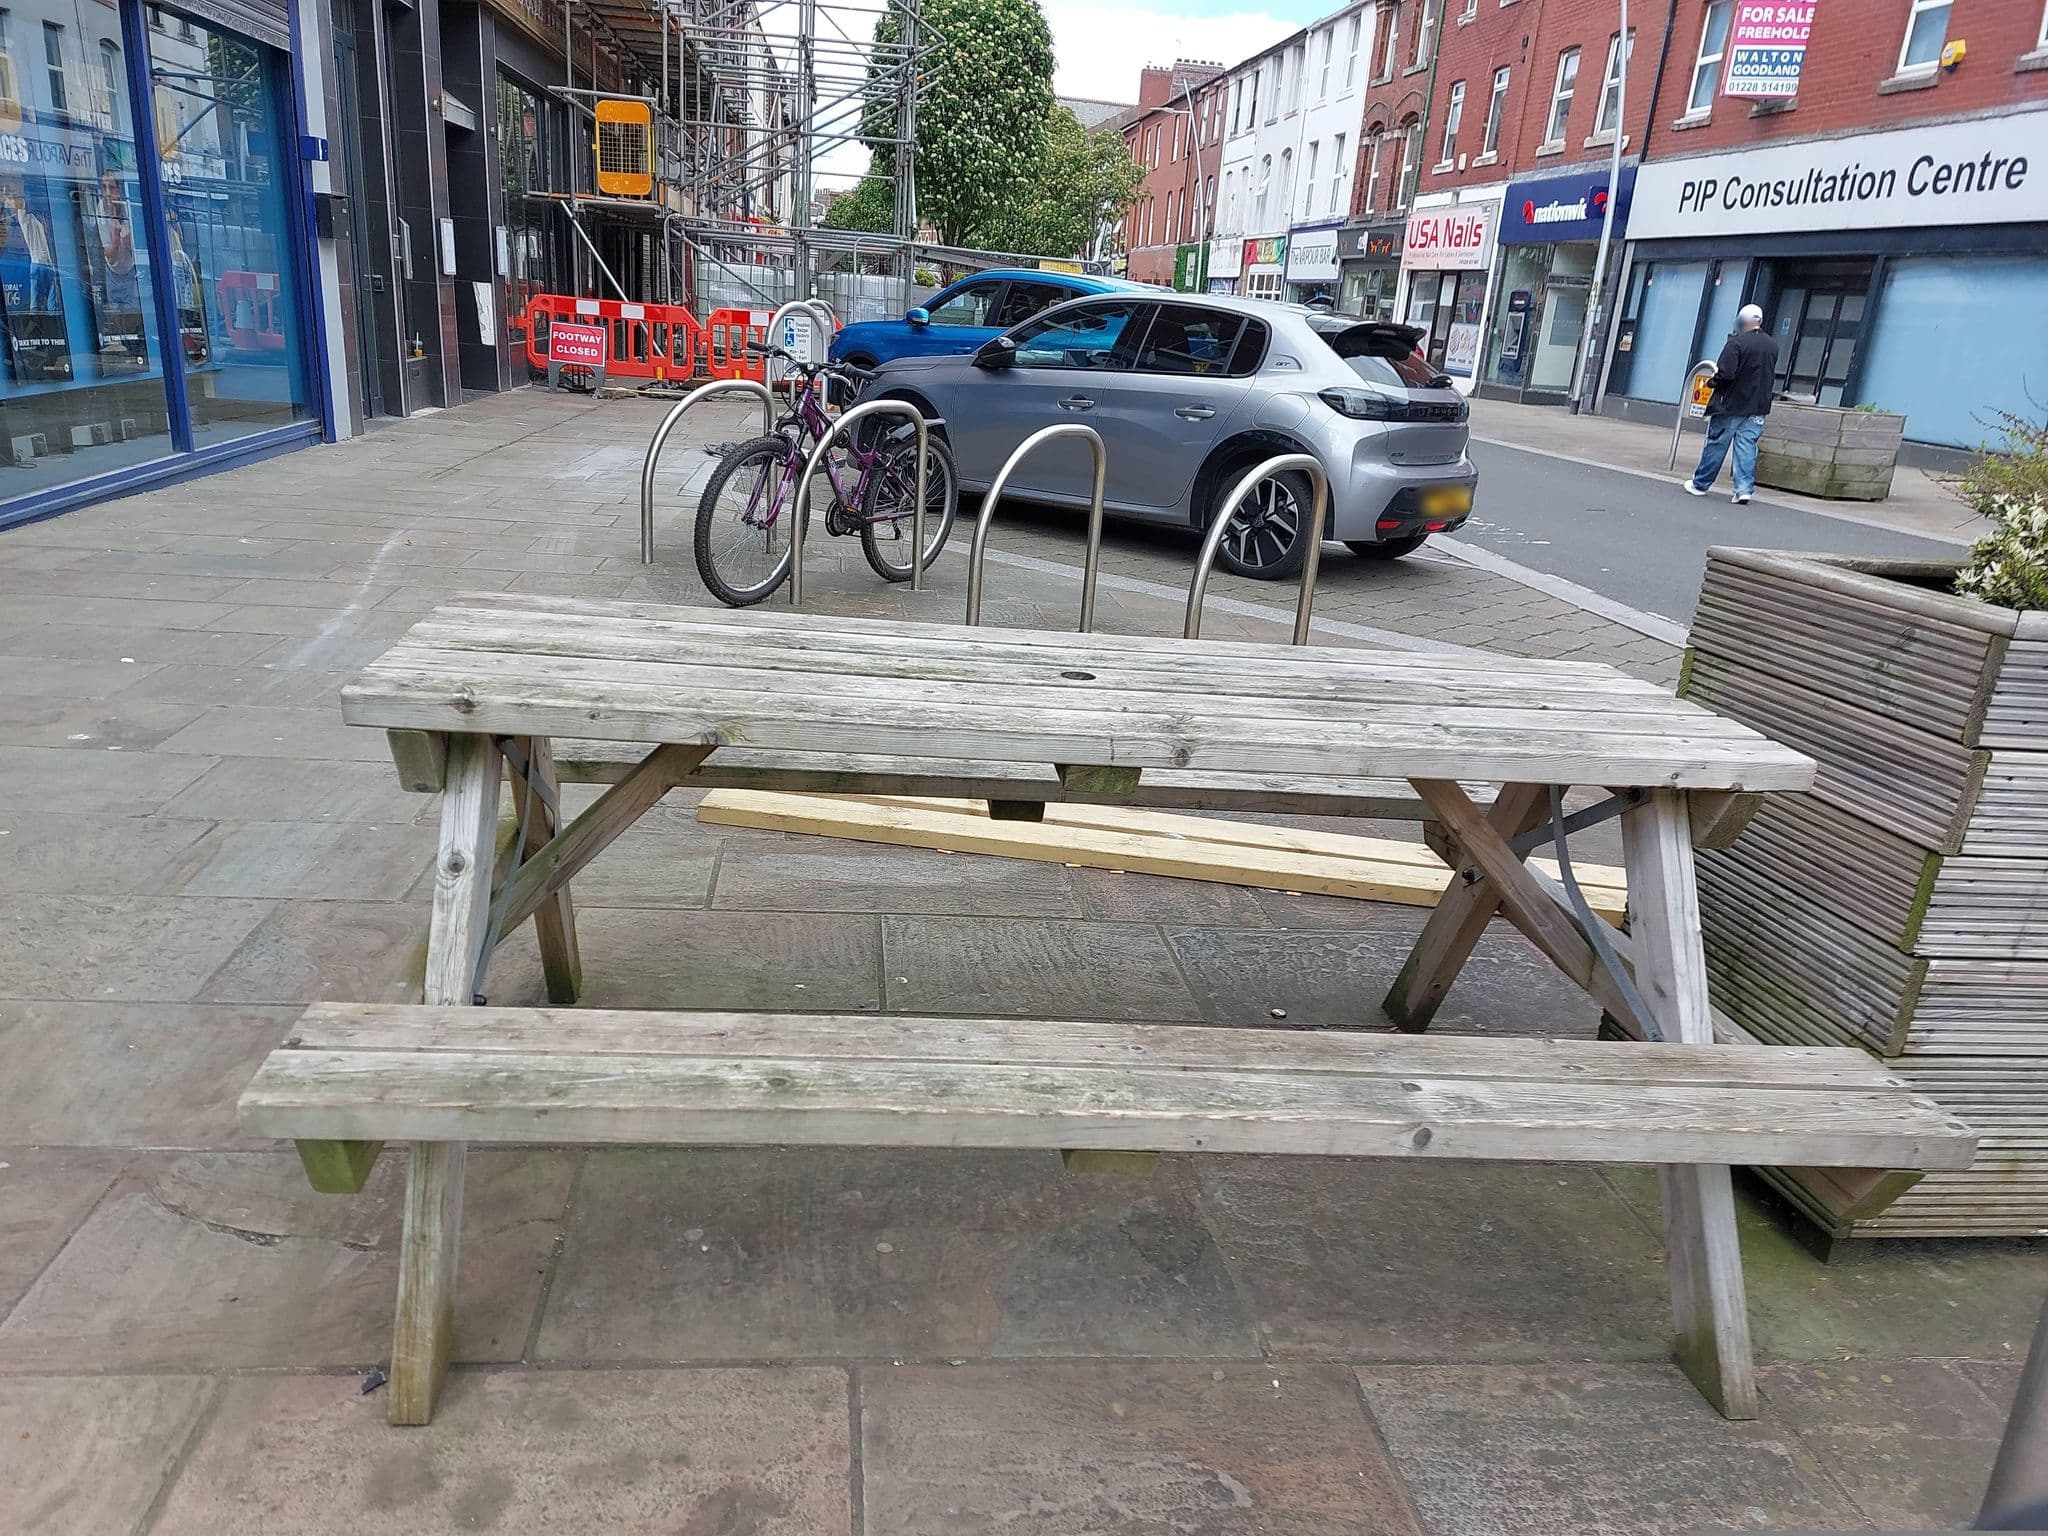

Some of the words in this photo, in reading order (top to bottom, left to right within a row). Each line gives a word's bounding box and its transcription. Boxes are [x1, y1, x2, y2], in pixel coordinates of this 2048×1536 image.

[1741, 7, 1774, 23] FOR
[1776, 7, 1815, 23] SALE
[1737, 26, 1811, 40] FREEHOLD
[1737, 51, 1803, 63] WALTON
[1733, 64, 1800, 76] GOODLAND
[1728, 81, 1758, 92] 01228
[1761, 82, 1797, 92] 514199
[1678, 178, 1718, 213] PIP
[1722, 162, 1897, 210] Consultation
[1907, 150, 2028, 196] Centre
[1533, 197, 1588, 225] nationwi
[1409, 218, 1439, 249] USA
[1443, 215, 1483, 249] Nails
[552, 331, 601, 344] FOOTWAY
[556, 344, 598, 357] CLOSED
